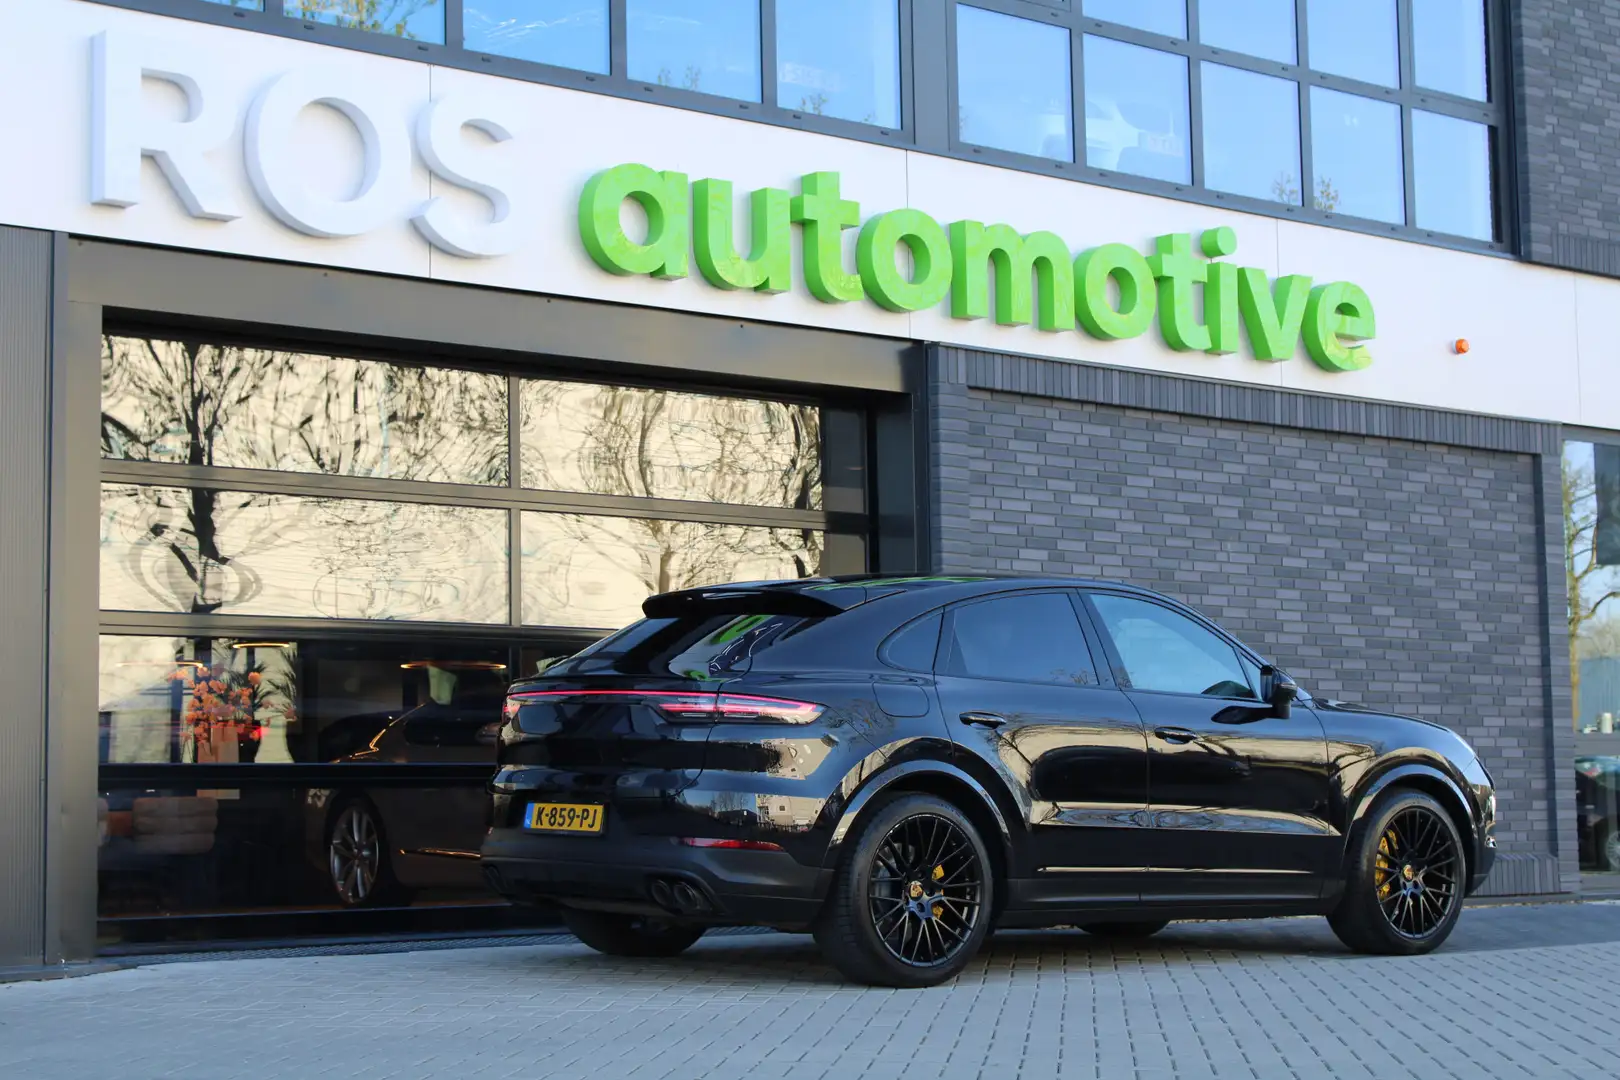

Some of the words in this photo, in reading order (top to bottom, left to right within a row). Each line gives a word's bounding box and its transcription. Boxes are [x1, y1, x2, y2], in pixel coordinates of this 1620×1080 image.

[90, 30, 514, 259] ROS
[578, 163, 1376, 373] automotive
[535, 806, 598, 829] K-859-PJ
